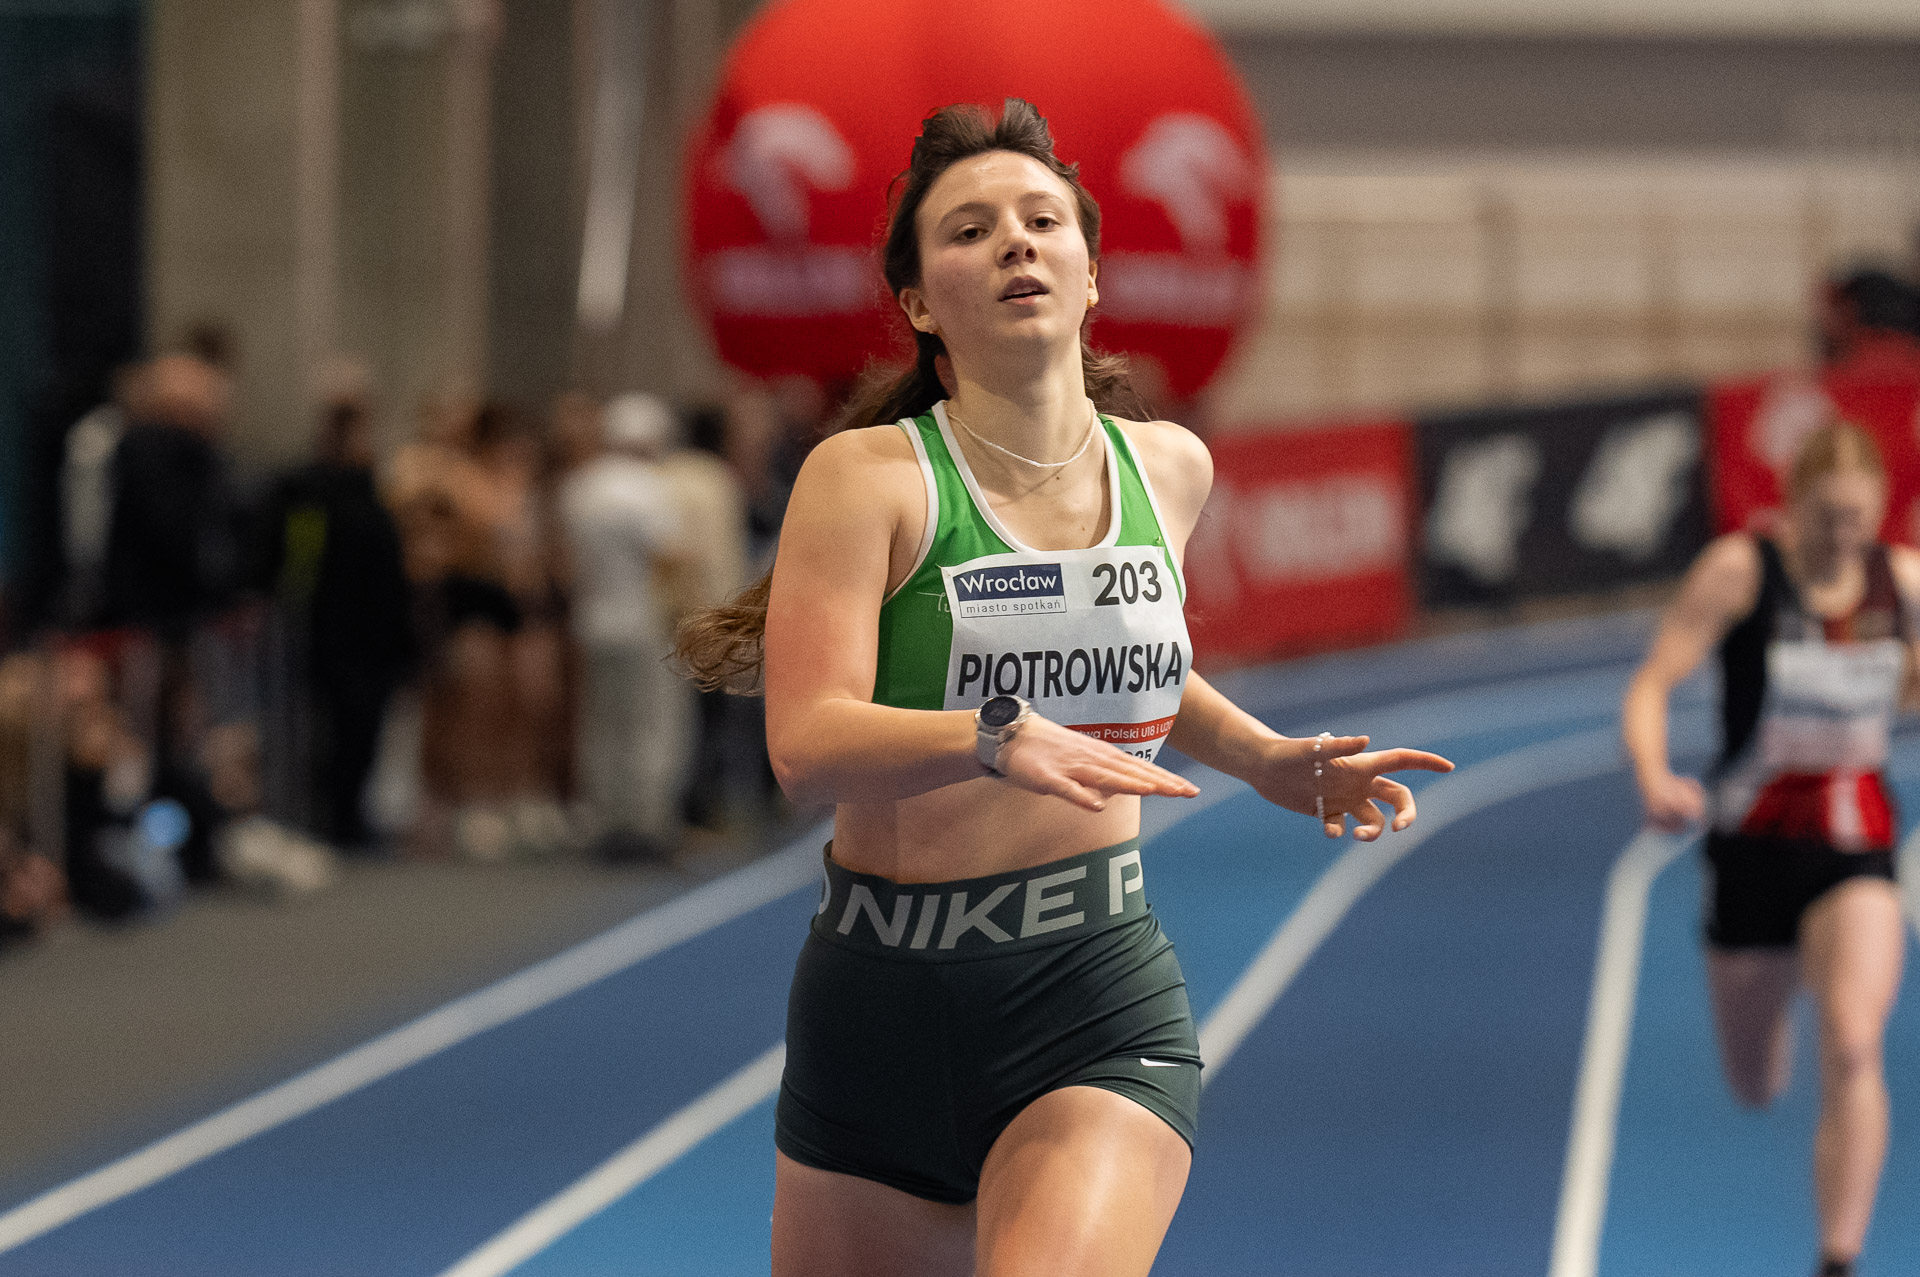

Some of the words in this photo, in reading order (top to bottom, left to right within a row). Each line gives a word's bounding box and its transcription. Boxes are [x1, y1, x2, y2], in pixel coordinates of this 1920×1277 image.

[960, 569, 1057, 594] Wrocław
[1092, 561, 1162, 607] 203
[966, 603, 1008, 613] miasto
[1013, 599, 1061, 612] spotkań
[957, 642, 1182, 698] PIOTROWSKA
[1104, 728, 1139, 738] Polski
[1141, 725, 1155, 737] U18
[836, 865, 1087, 950] NIKE
